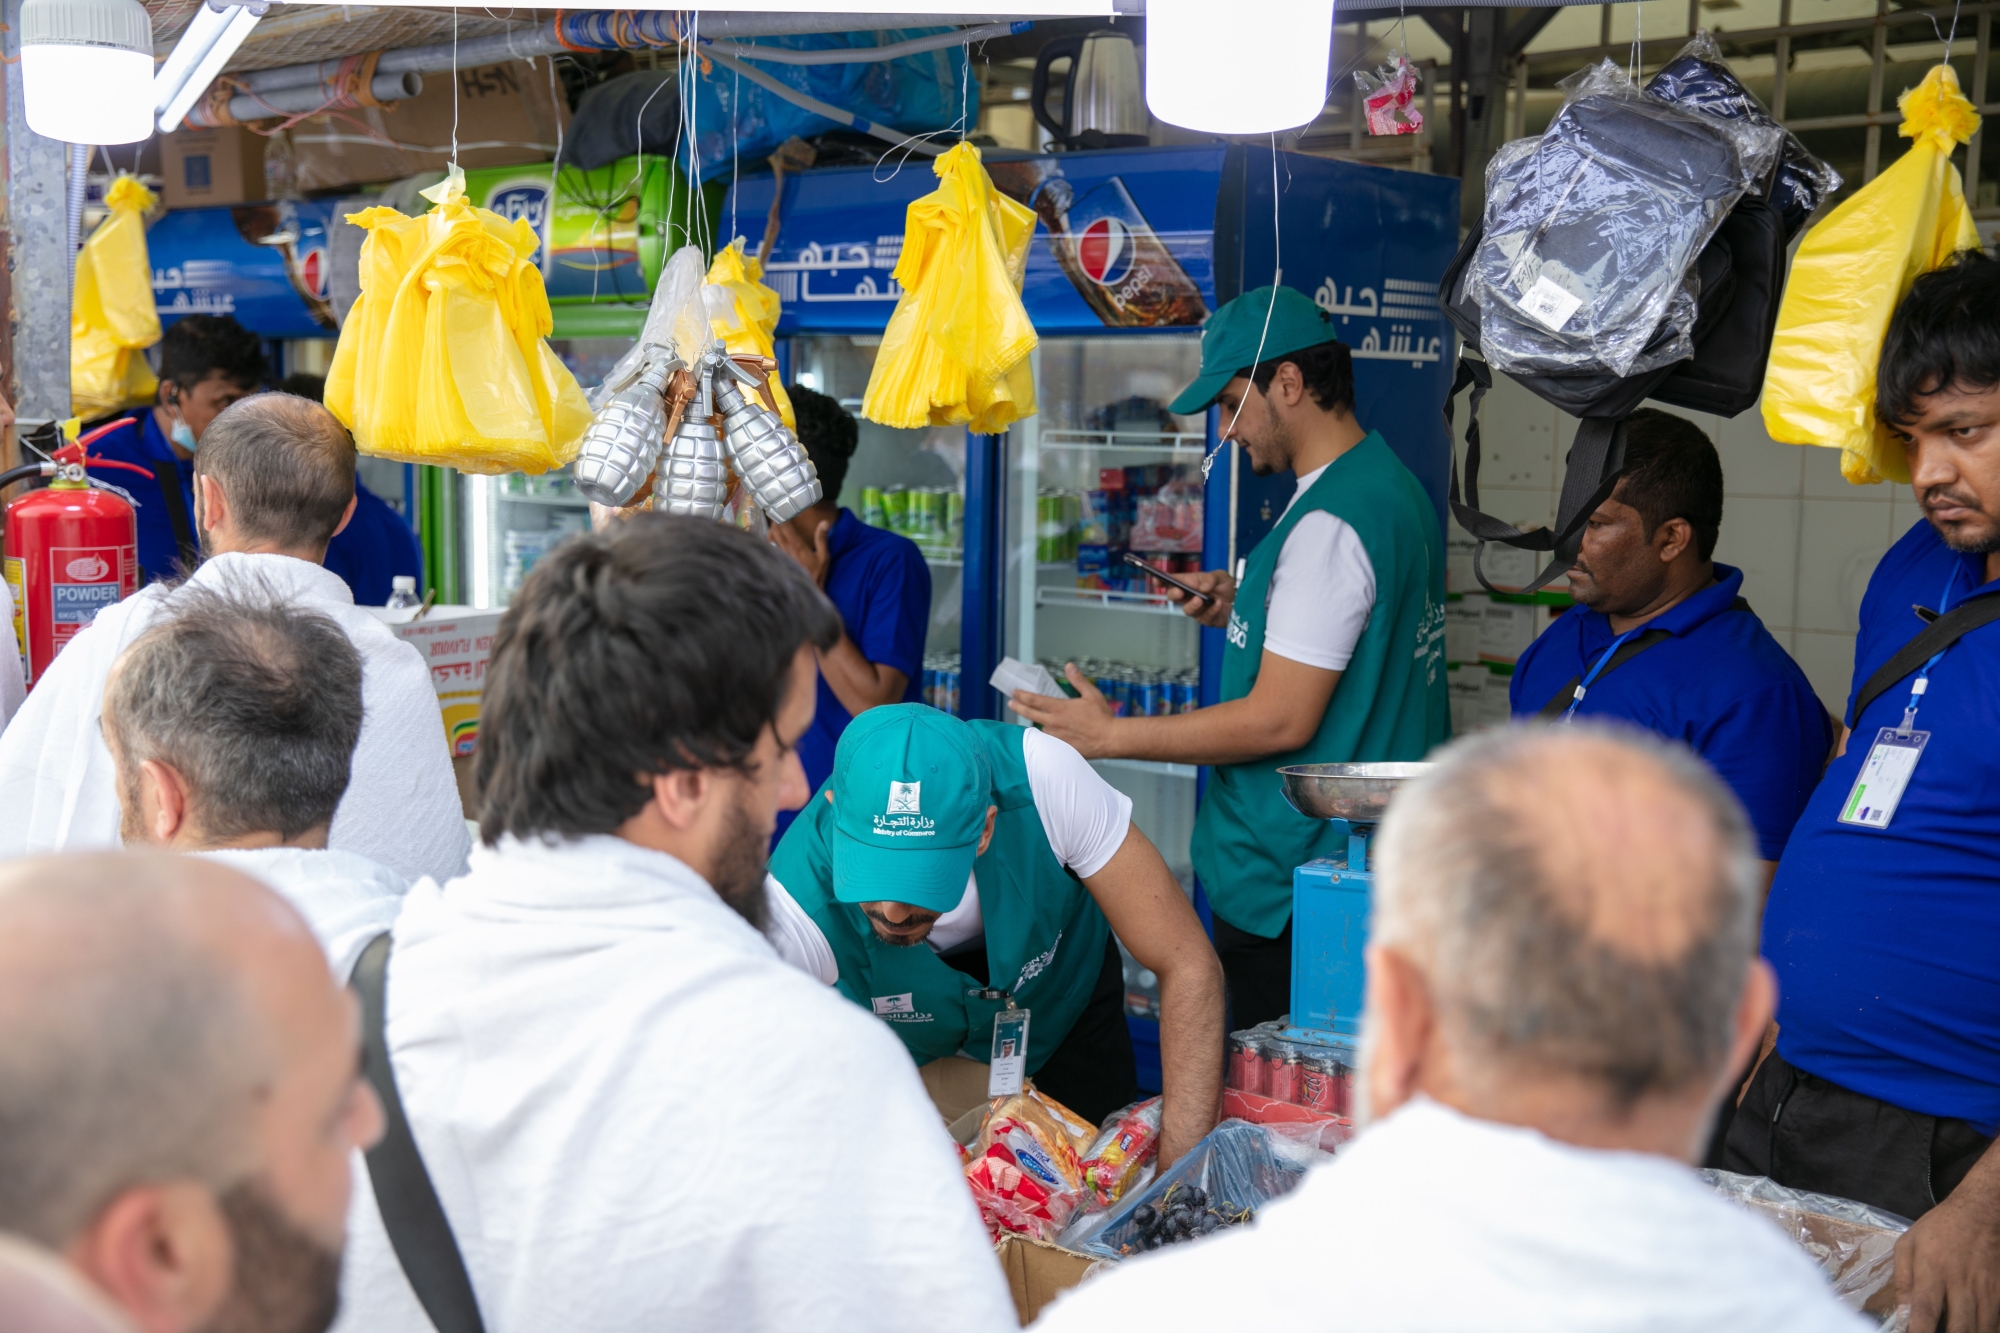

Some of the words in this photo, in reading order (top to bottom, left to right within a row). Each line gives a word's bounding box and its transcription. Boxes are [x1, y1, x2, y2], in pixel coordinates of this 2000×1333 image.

[1113, 263, 1154, 313] pepsi
[1349, 324, 1442, 369] عيشه
[57, 586, 119, 601] POWDER
[873, 814, 910, 829] التجارة
[910, 815, 935, 829] وزارة
[903, 829, 936, 837] Commerce
